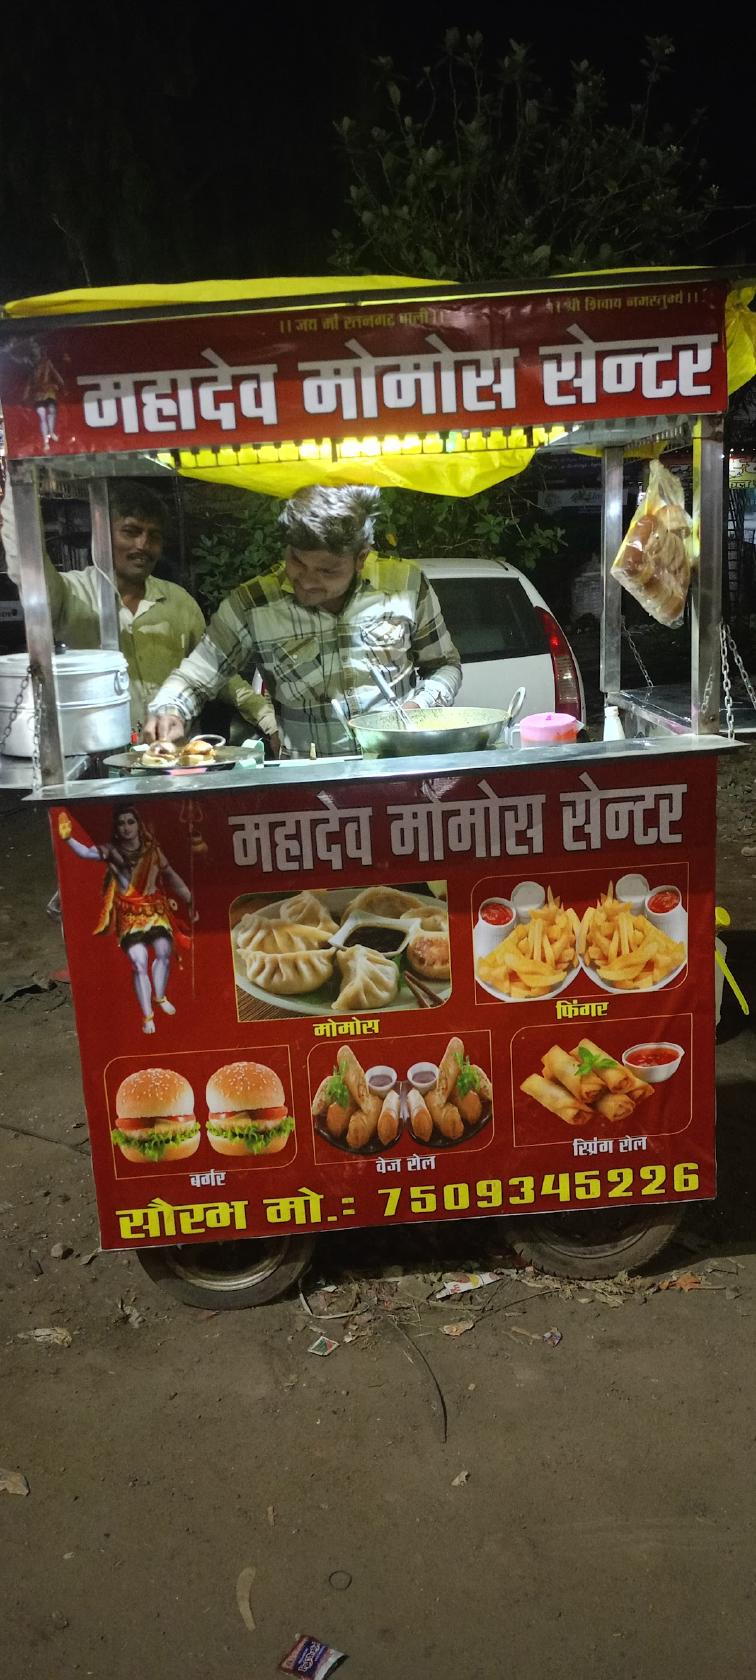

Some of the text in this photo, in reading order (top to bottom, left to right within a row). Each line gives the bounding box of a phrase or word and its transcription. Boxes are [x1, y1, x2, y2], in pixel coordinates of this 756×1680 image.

[585, 296, 622, 312] शिवाय
[295, 318, 318, 332] जय
[77, 323, 719, 433] महादेव मोमोस सेन्टर
[228, 771, 688, 873] महादेव मोमोस सेन्टर
[555, 999, 610, 1020] फिंगर
[313, 1016, 381, 1038] मोमोस
[572, 1134, 648, 1157] स्प्रिंग रोल
[375, 1153, 437, 1174] वेज रोल
[188, 1168, 227, 1188] बर्गर
[115, 1197, 249, 1240] सौरभ
[377, 1161, 700, 1217] 7509345226
